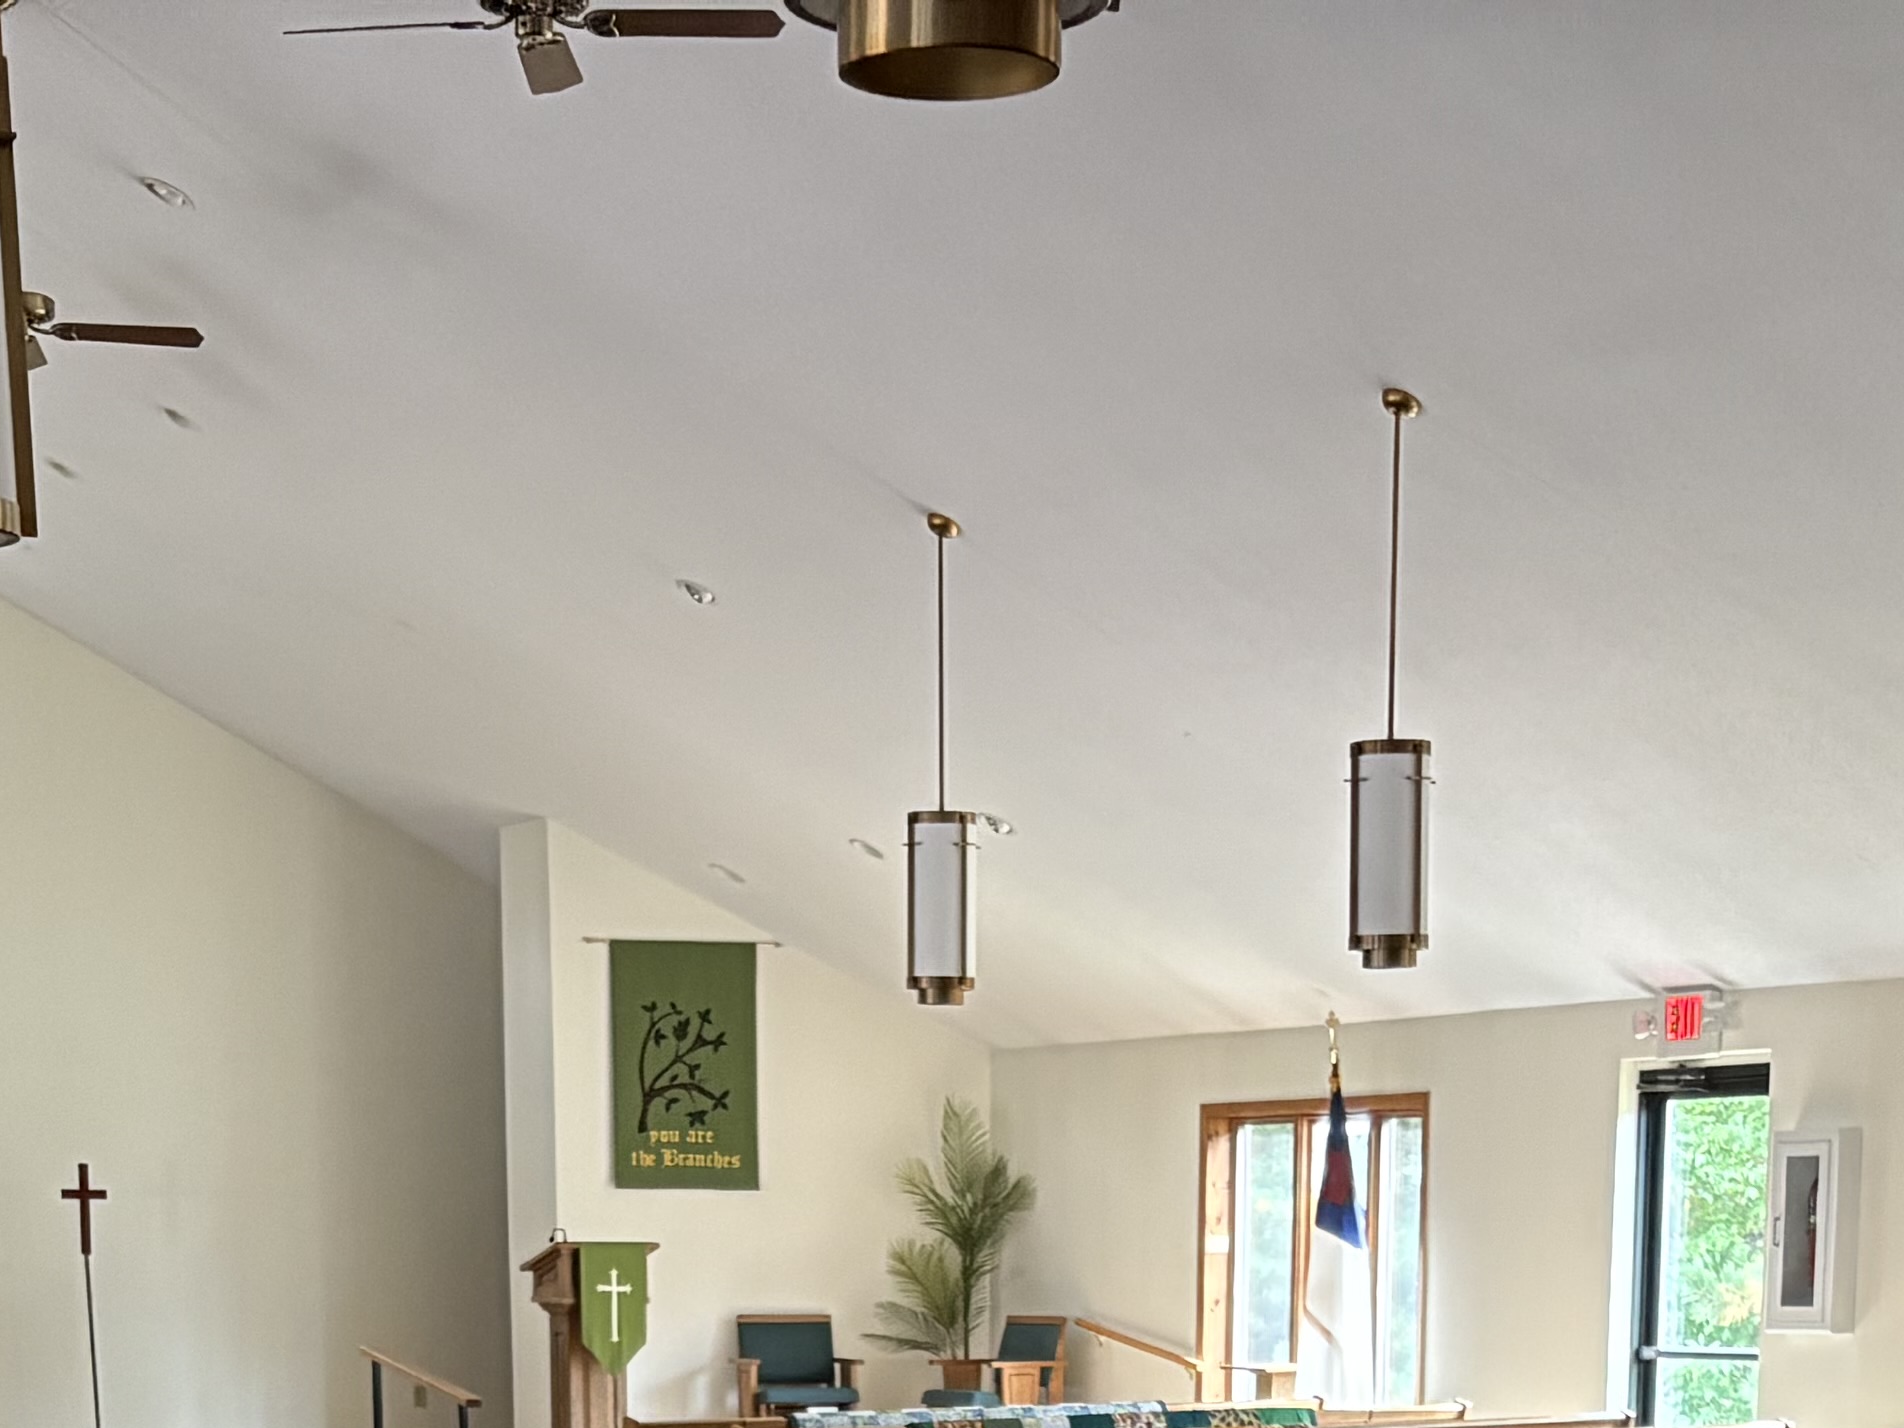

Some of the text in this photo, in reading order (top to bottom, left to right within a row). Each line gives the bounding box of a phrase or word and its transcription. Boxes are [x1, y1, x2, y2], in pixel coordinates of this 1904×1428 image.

[649, 1130, 715, 1147] you are
[631, 1148, 741, 1169] the Branches
